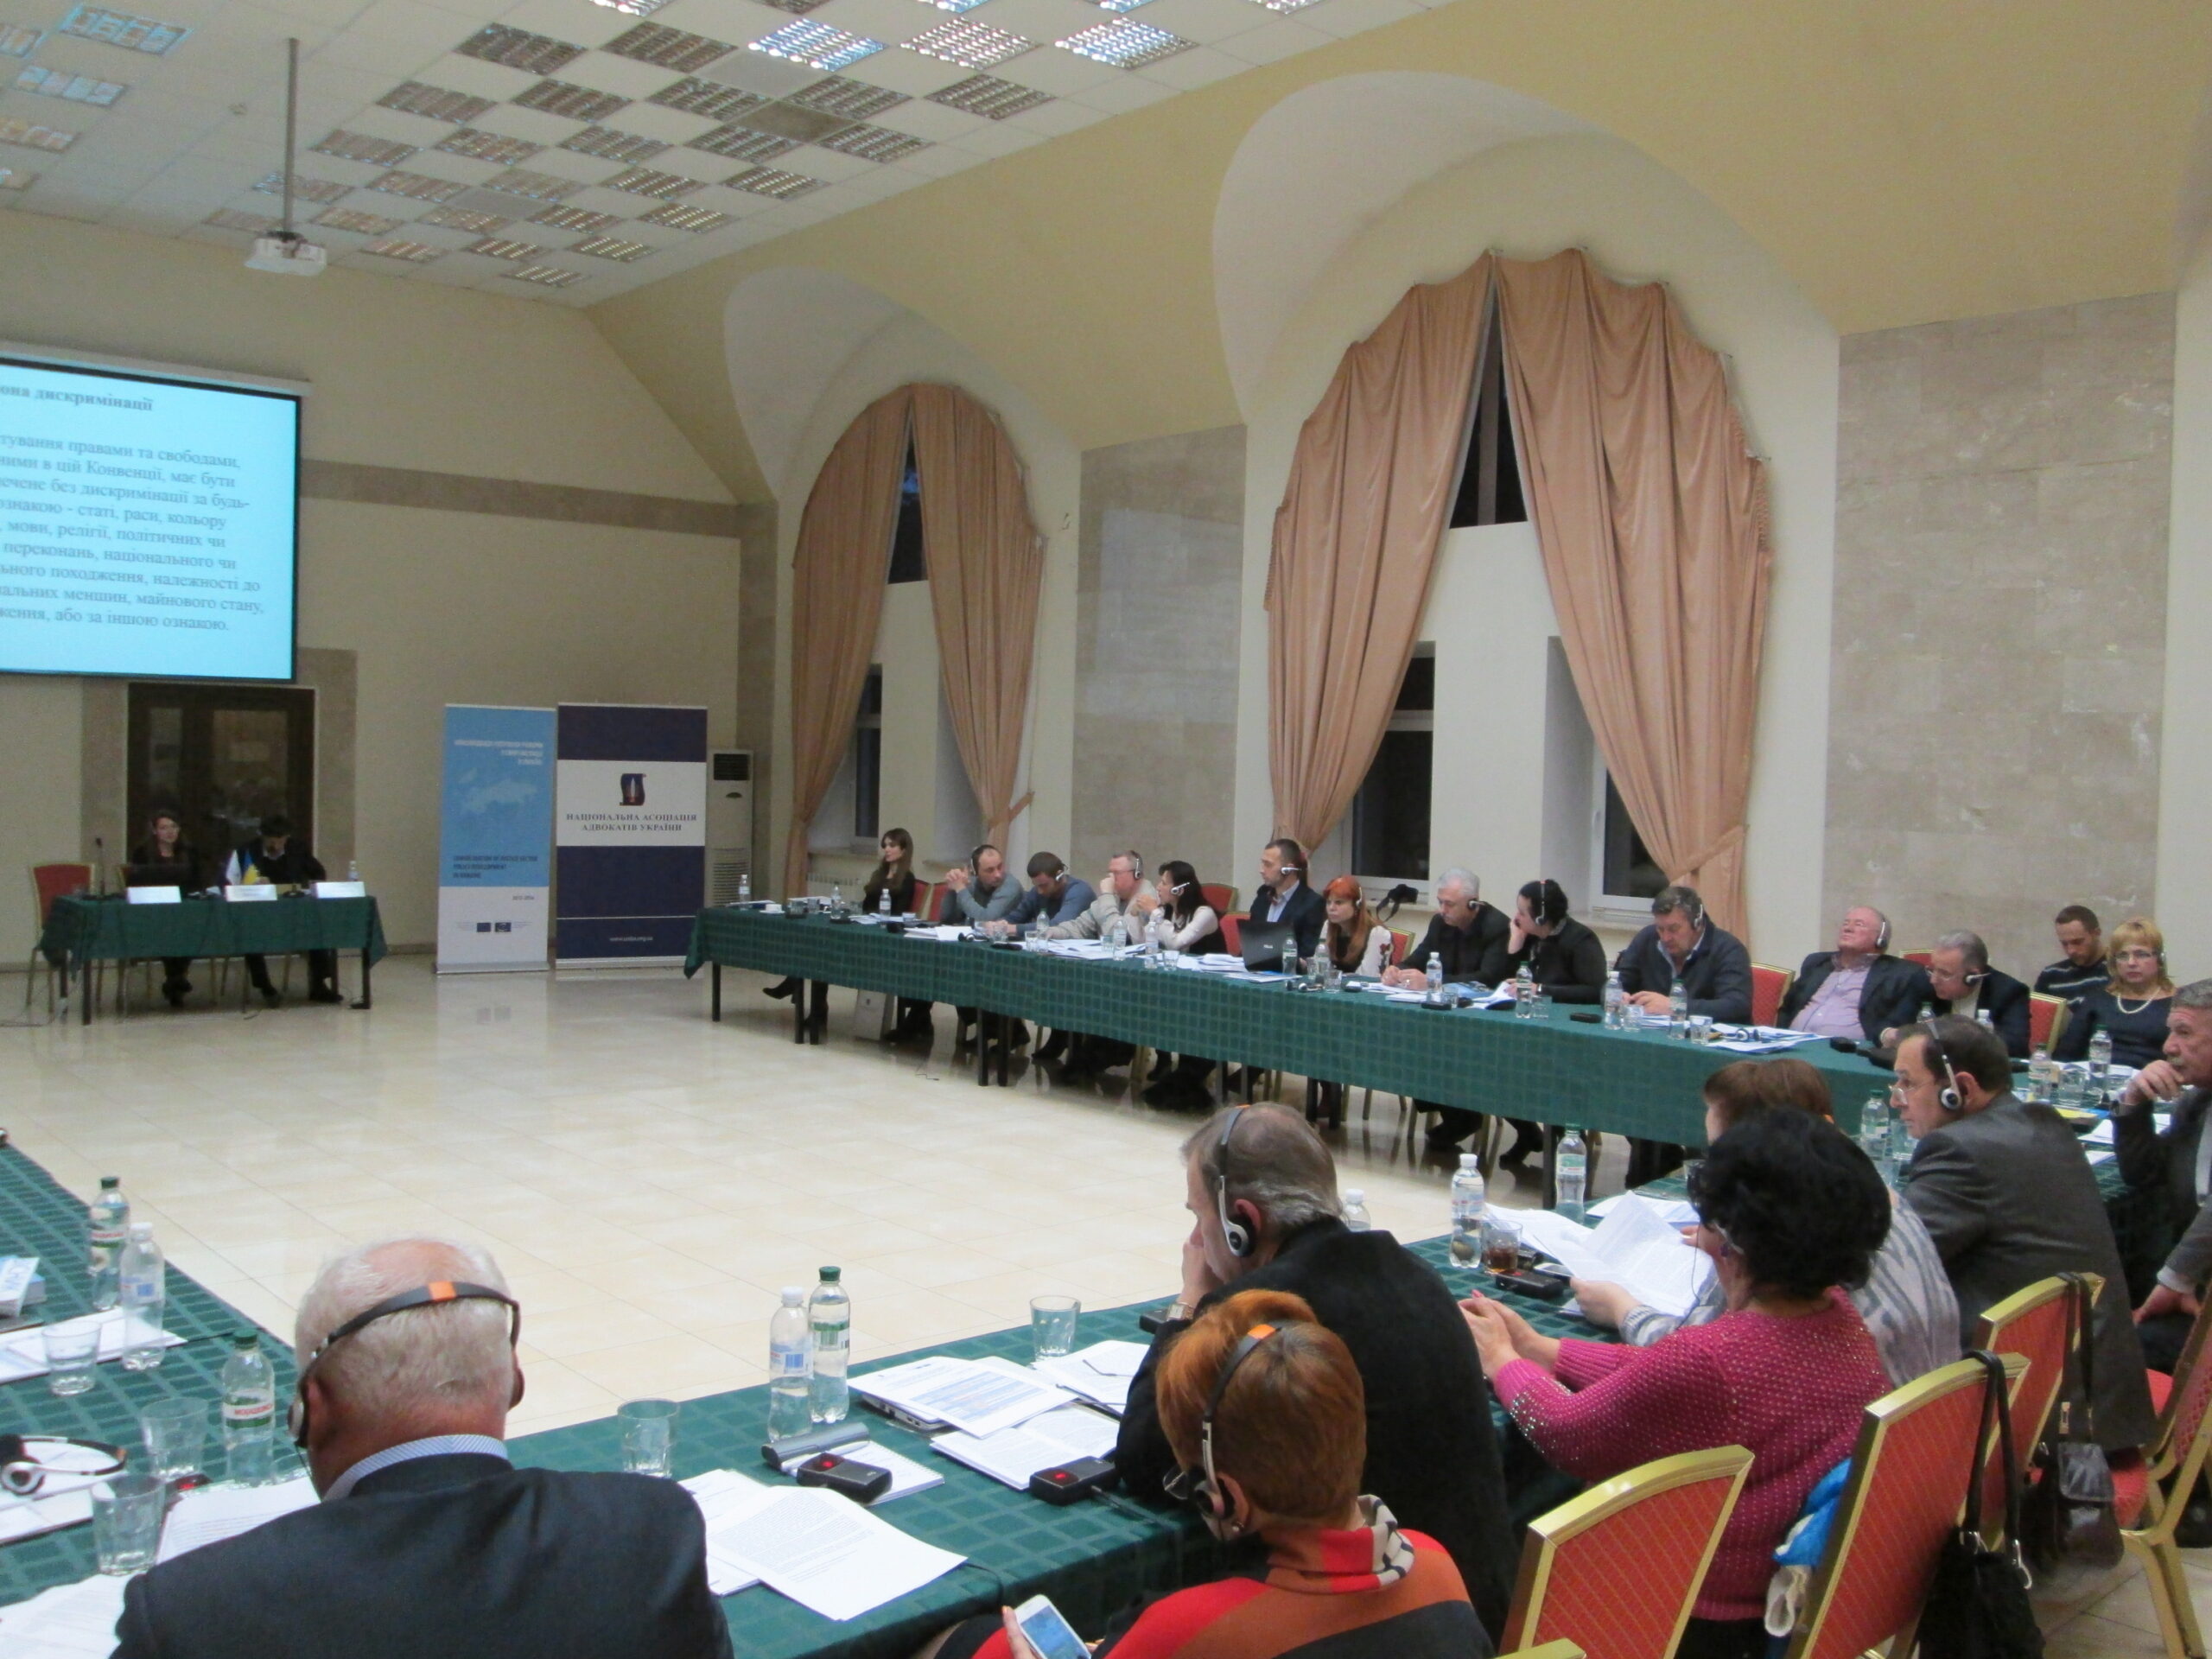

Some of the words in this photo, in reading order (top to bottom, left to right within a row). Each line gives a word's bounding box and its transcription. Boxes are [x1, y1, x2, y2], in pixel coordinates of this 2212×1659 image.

[35, 389, 154, 411] дискримінації
[68, 442, 134, 456] правами
[138, 448, 153, 459] та
[43, 461, 51, 470] в
[57, 458, 81, 474] цій
[86, 460, 166, 481] Конвенції,
[201, 472, 236, 489] бути
[51, 479, 76, 493] без
[80, 485, 189, 504] дискримінації
[193, 495, 207, 505] за
[212, 493, 250, 510] будь-
[78, 505, 119, 520] статі,
[124, 510, 162, 524] раси,
[168, 513, 226, 531] кольору
[8, 521, 53, 537] мови,
[117, 528, 203, 547] політичних
[207, 537, 226, 548] чи
[3, 543, 99, 562] переконань,
[104, 548, 214, 568] національного
[219, 559, 236, 569] чи
[51, 568, 149, 585] походження,
[153, 575, 238, 590] належності
[242, 582, 261, 592] до
[63, 590, 131, 605] меншин,
[136, 593, 216, 609] майнового
[220, 600, 264, 615] стану,
[55, 607, 82, 622] або
[88, 613, 102, 623] за
[108, 609, 158, 626] іншою
[162, 617, 229, 631] ознакою.
[566, 813, 639, 822] НАЦІОНАЛЬНА
[643, 814, 697, 823] АСОЦІАЦІЯ
[640, 823, 683, 831] УКРАЇНИ
